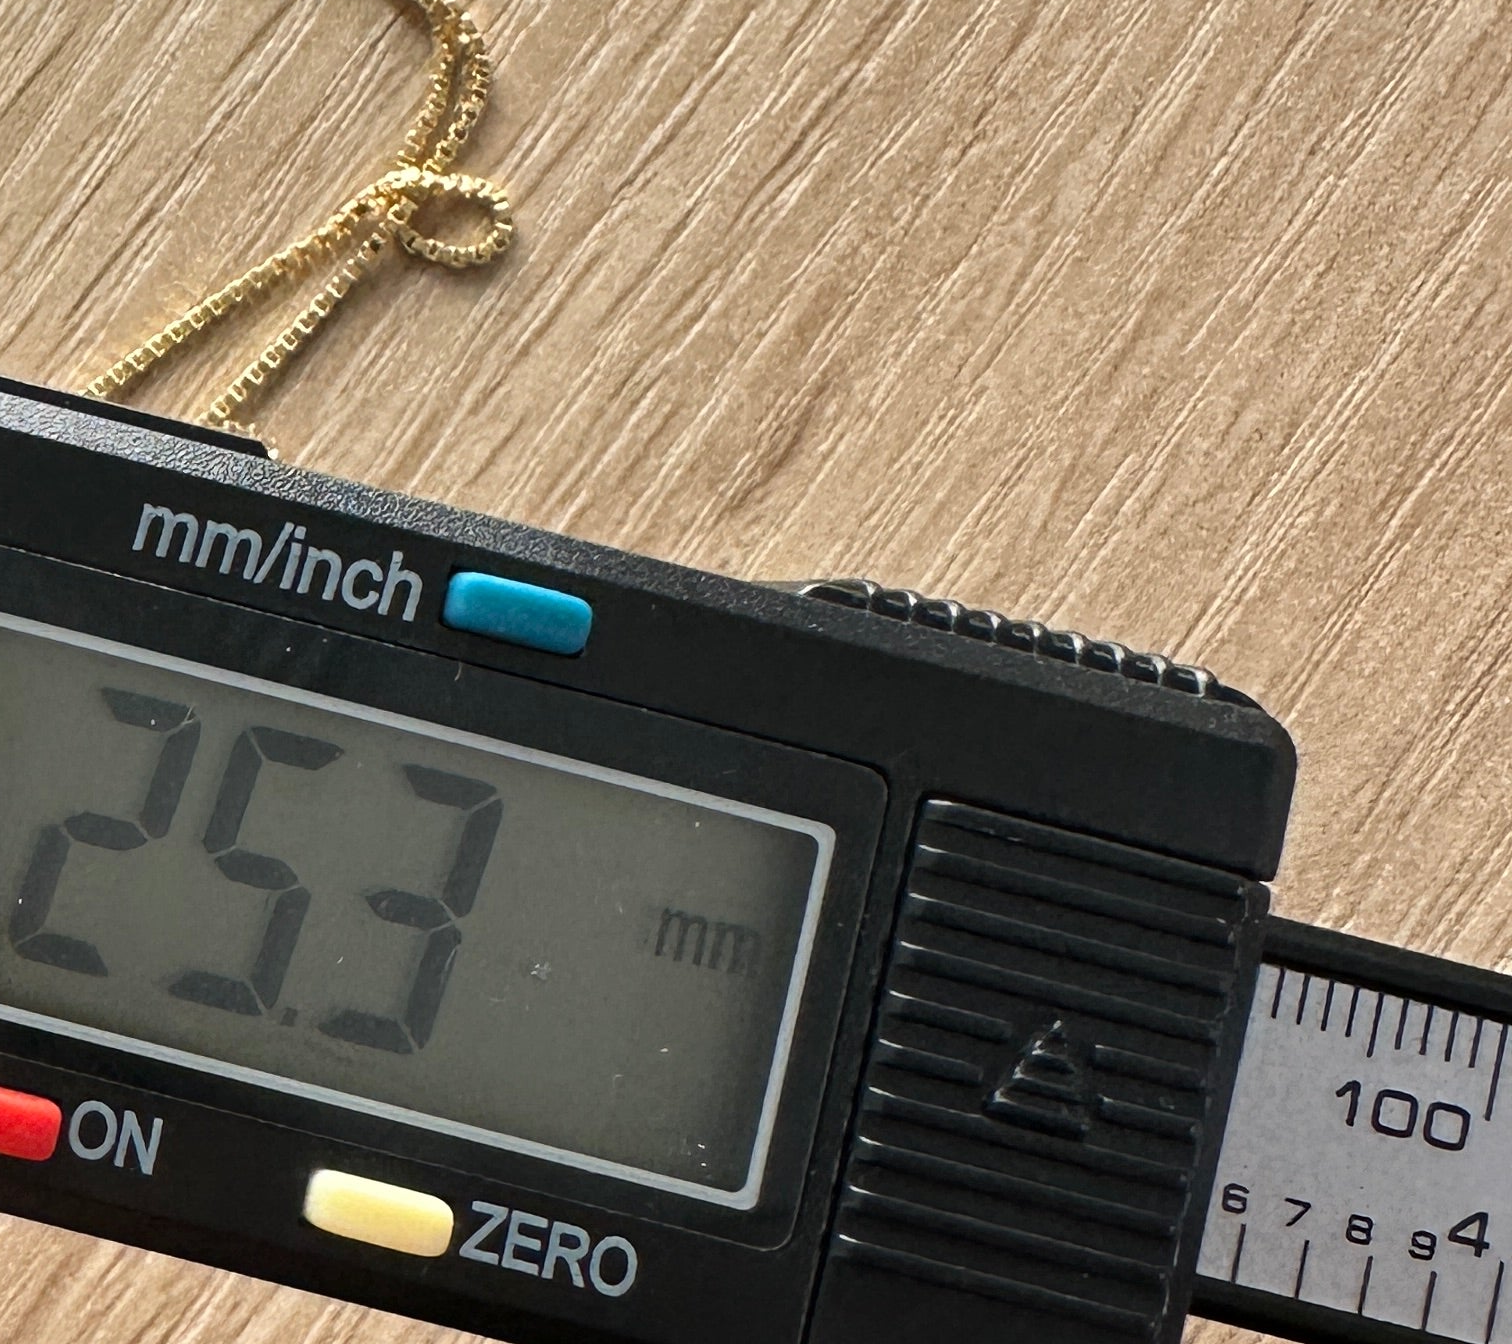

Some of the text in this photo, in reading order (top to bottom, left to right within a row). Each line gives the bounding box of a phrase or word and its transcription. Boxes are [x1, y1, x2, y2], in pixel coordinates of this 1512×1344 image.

[132, 501, 423, 621] mm/inch
[9, 686, 760, 1055] 25.3 mm
[68, 1101, 163, 1176] ON
[1335, 1079, 1471, 1151] 100
[458, 1203, 639, 1298] ZERO
[1221, 1183, 1489, 1261] 6 7 8 9 4
